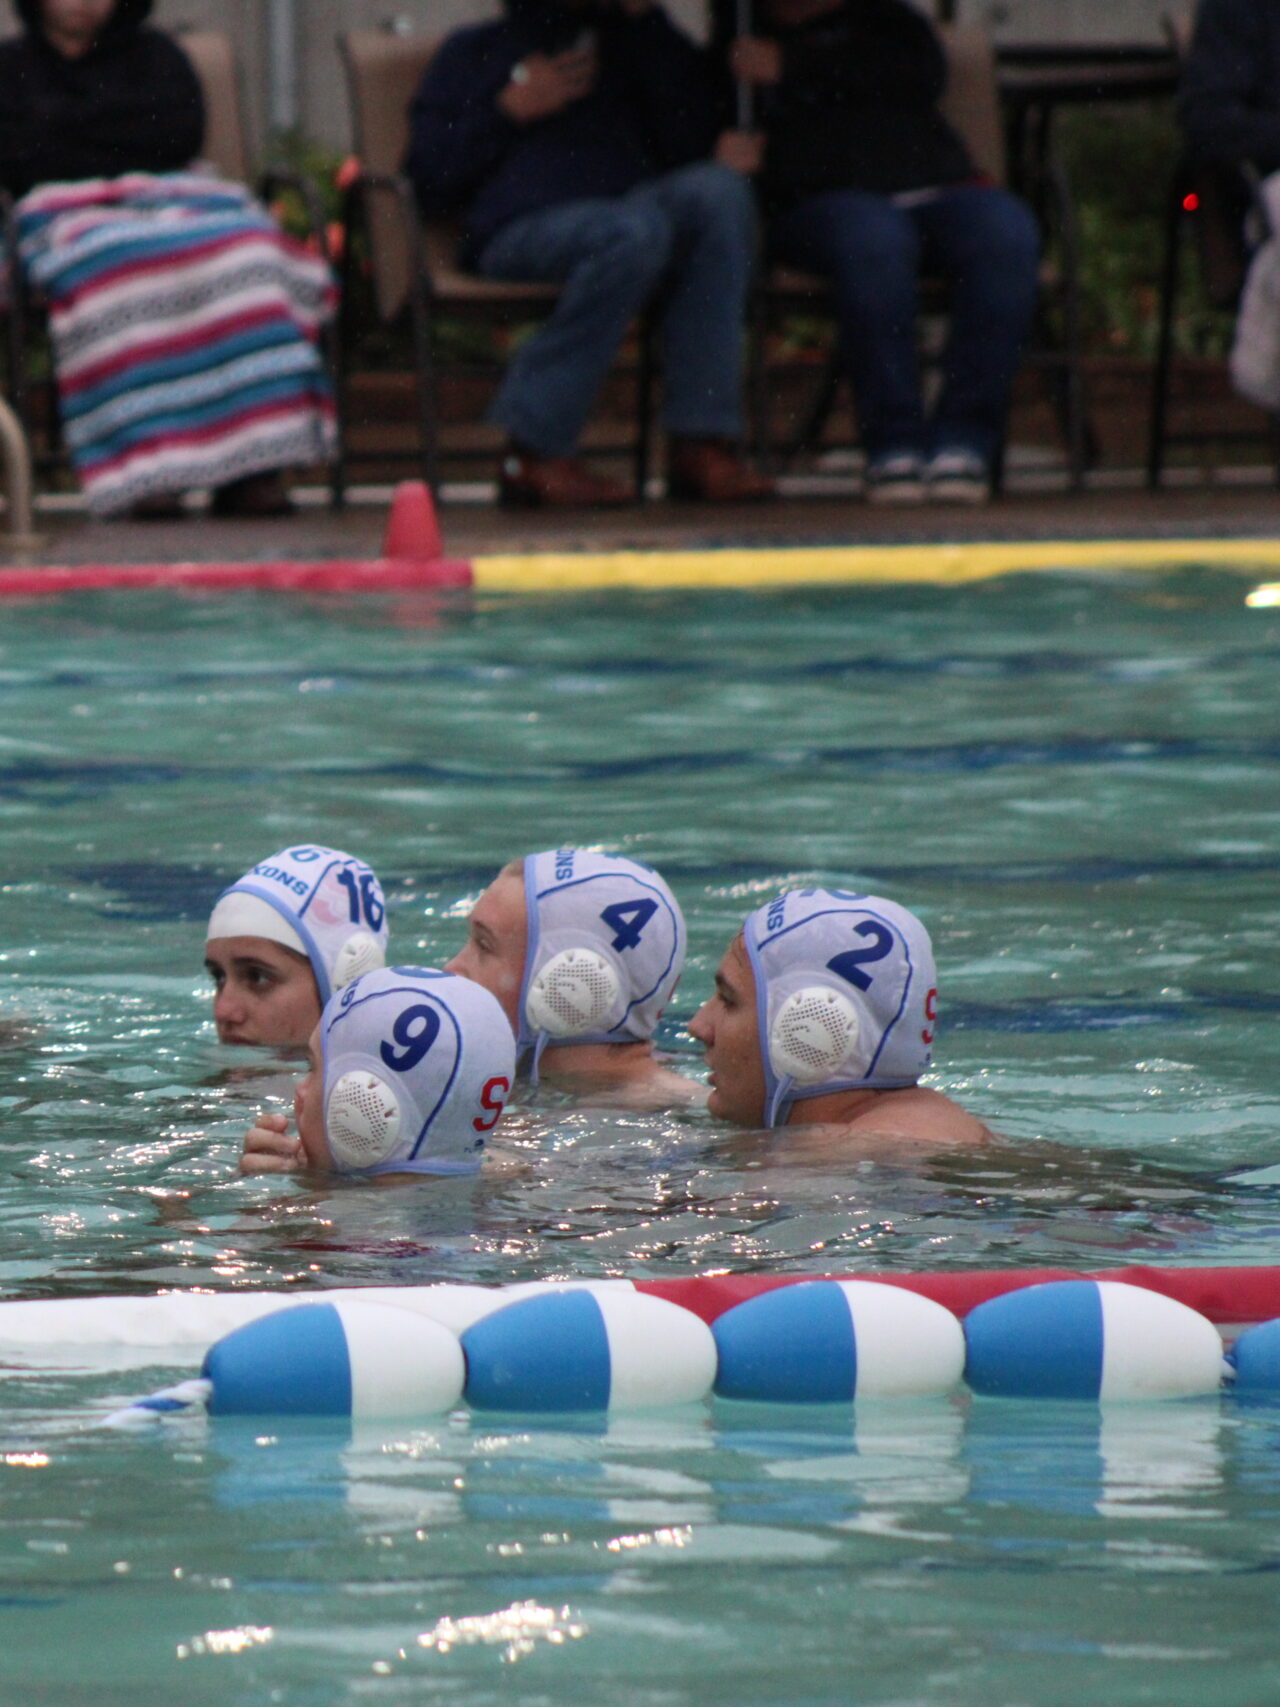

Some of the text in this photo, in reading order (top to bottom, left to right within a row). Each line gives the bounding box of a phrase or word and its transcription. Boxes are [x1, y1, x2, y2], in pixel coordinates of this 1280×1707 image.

[252, 864, 310, 896] XONS
[336, 868, 384, 932] 16
[599, 898, 659, 953] 4
[825, 920, 894, 992] 2
[379, 1004, 441, 1072] 9
[472, 1076, 510, 1132] S
